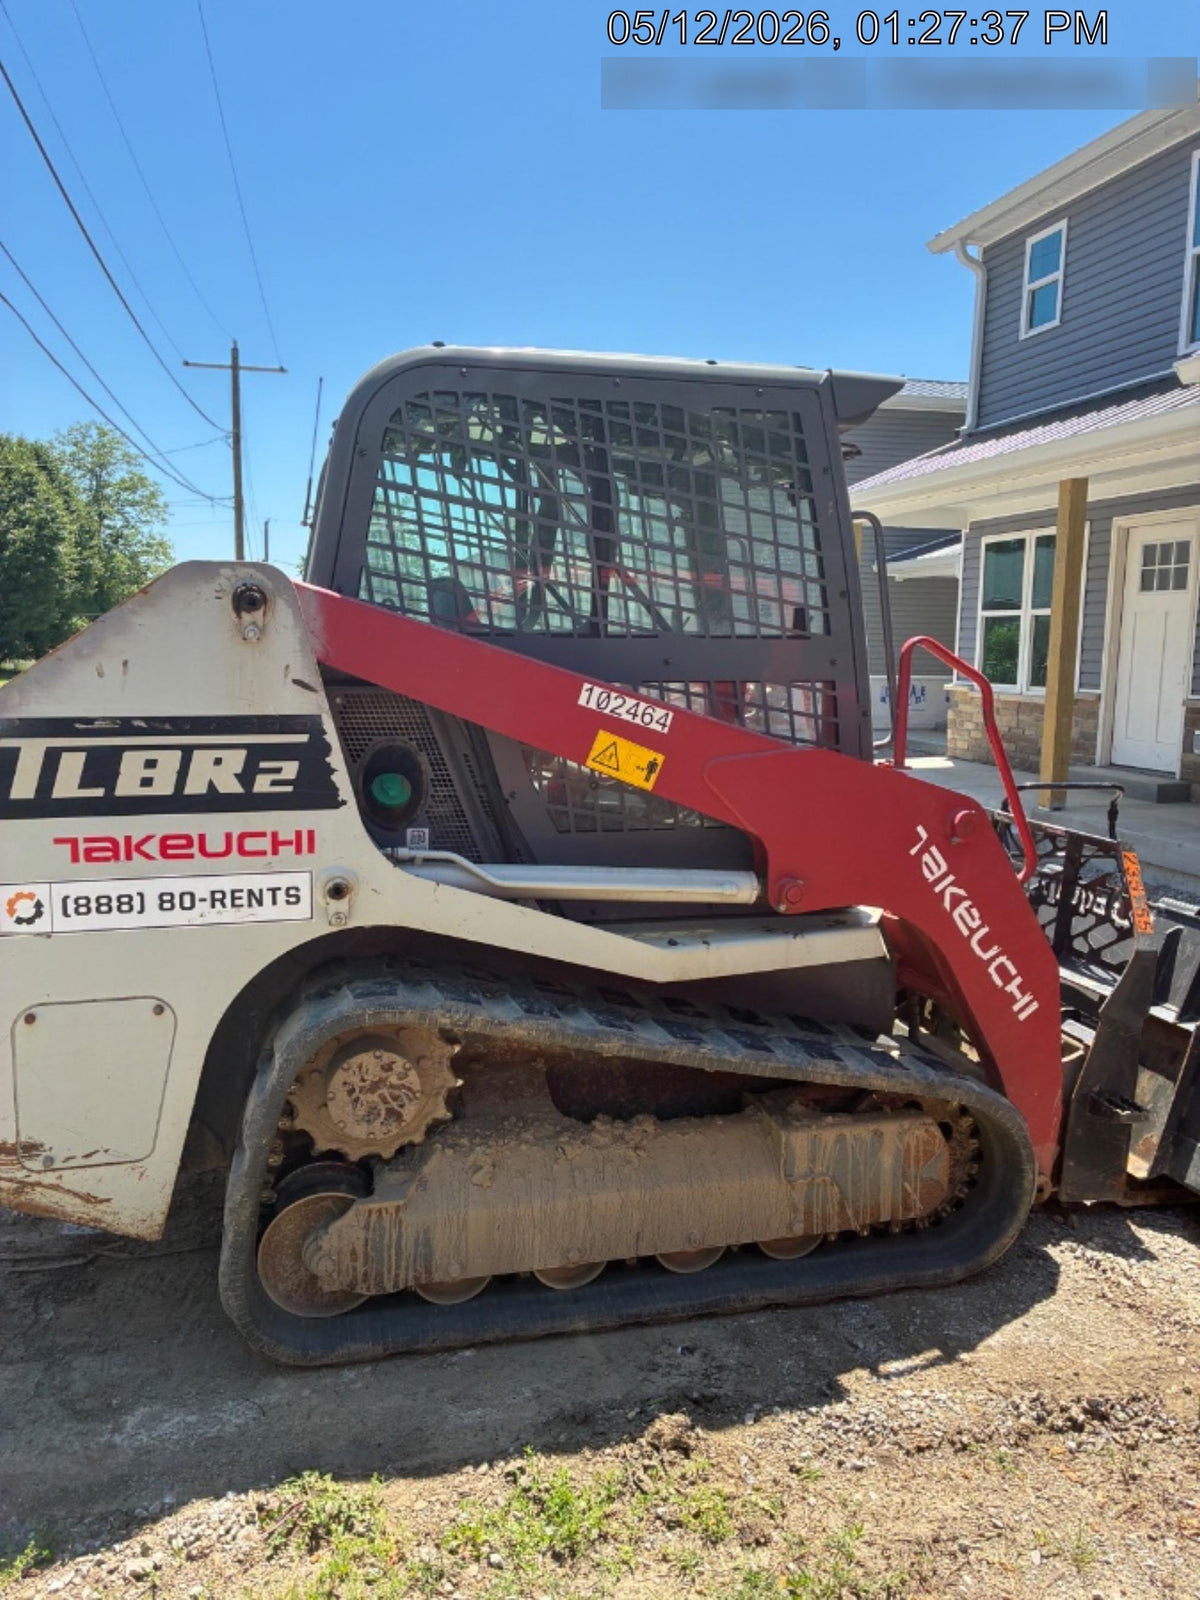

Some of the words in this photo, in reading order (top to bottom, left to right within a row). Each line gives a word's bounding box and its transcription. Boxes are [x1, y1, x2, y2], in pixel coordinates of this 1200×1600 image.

[584, 686, 670, 731] 102464
[61, 892, 146, 918] (888)
[158, 886, 301, 912] 80-RENTS
